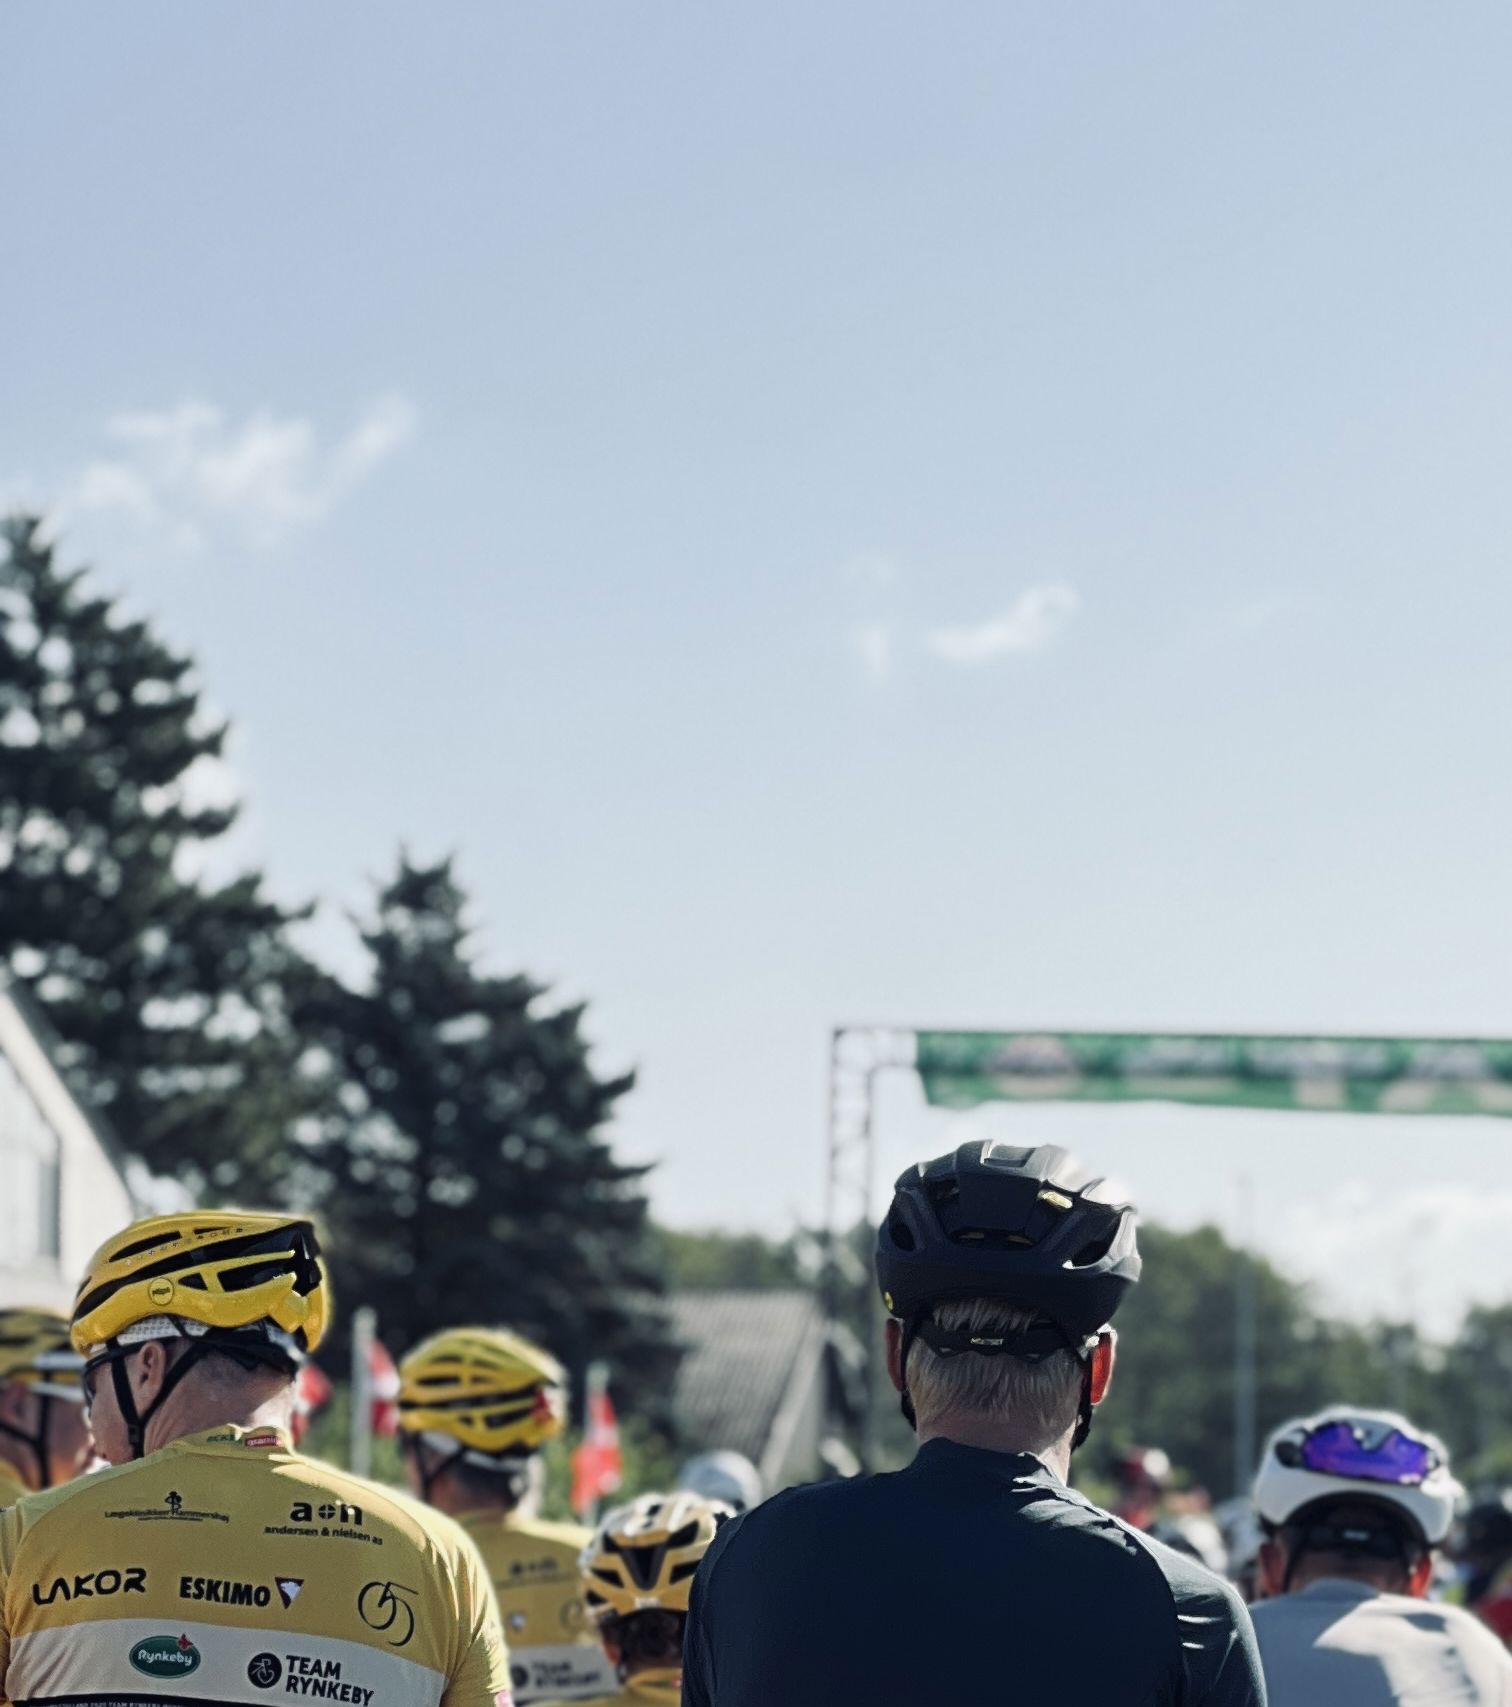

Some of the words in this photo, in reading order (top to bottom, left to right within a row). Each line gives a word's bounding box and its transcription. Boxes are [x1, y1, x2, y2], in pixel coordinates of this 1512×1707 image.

[264, 1526, 318, 1537] andersen
[321, 1527, 330, 1537] &
[332, 1527, 371, 1542] nielsen
[32, 1568, 147, 1606] LAKOR
[179, 1576, 272, 1607] ESKIMO
[137, 1649, 193, 1667] Rynkeby
[285, 1655, 342, 1681] TEAM
[285, 1675, 375, 1707] RYNKEBY
